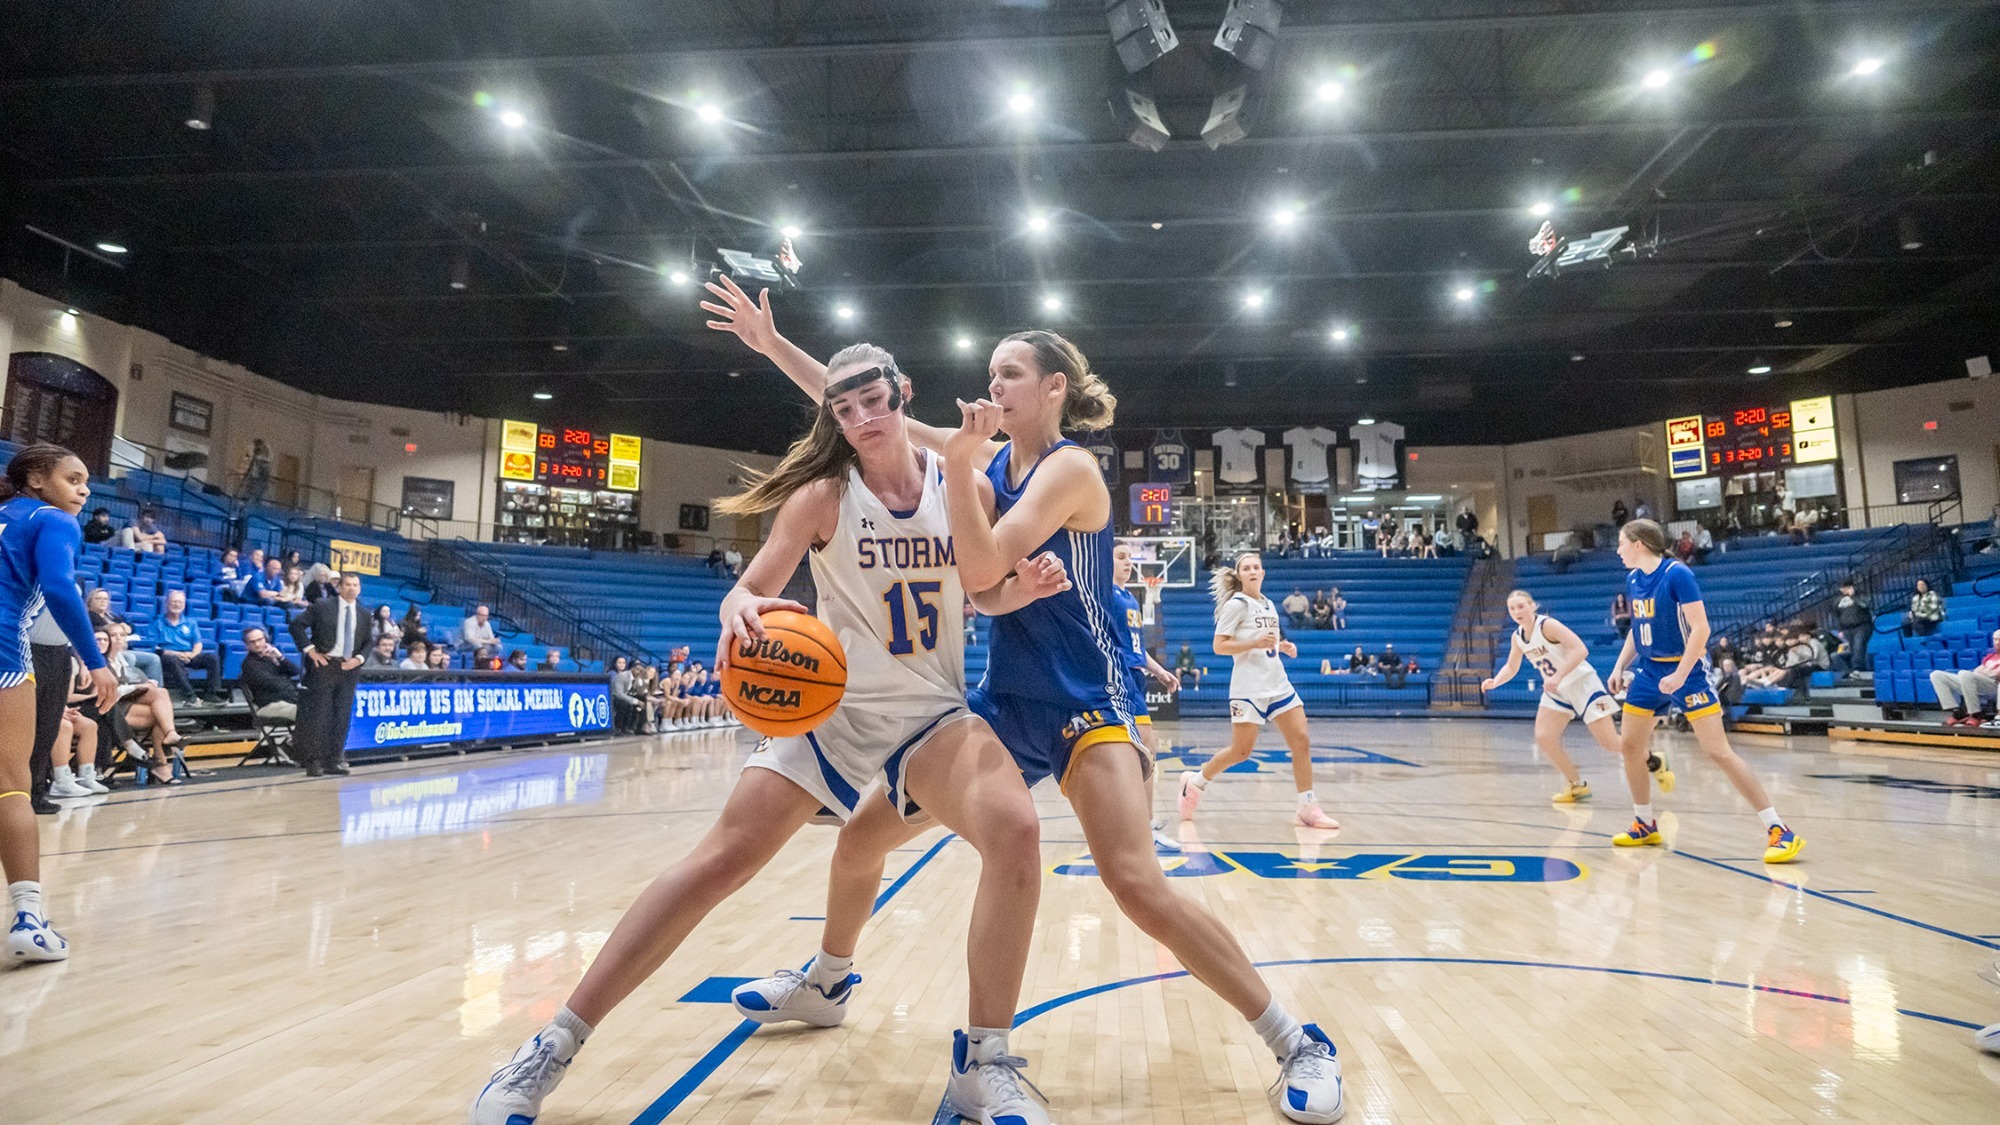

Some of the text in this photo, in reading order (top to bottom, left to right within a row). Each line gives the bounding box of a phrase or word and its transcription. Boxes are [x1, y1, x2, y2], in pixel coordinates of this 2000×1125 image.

[1735, 408, 1766, 425] 2:20
[1771, 412, 1790, 428] 52
[564, 428, 591, 445] 2:20
[1706, 421, 1725, 437] 68
[1759, 426, 1769, 437] 4
[539, 433, 556, 449] 68
[593, 440, 609, 455] 52
[583, 449, 591, 459] 4
[1158, 454, 1180, 470] 30
[1712, 452, 1721, 465] 3
[1726, 450, 1734, 462] 3
[1767, 446, 1774, 457] 1
[1782, 443, 1791, 456] 3
[540, 462, 548, 473] 3
[552, 463, 559, 475] 3
[587, 468, 592, 478] 1
[598, 469, 605, 480] 3
[1141, 488, 1169, 501] 2:20
[1147, 504, 1162, 522] 17
[333, 548, 380, 569] VSITORS
[858, 535, 957, 569] STORM
[1632, 598, 1655, 618] SAU
[881, 580, 943, 656] 15
[1127, 608, 1142, 628] SAU
[1640, 623, 1653, 646] 10
[739, 638, 820, 673] Wilson
[356, 688, 563, 717] FOLLOW US ON SOCIAL MEDIA!
[738, 681, 802, 708] NCAA
[1684, 692, 1709, 708] SAU
[375, 720, 462, 744] @GoSoutheastern
